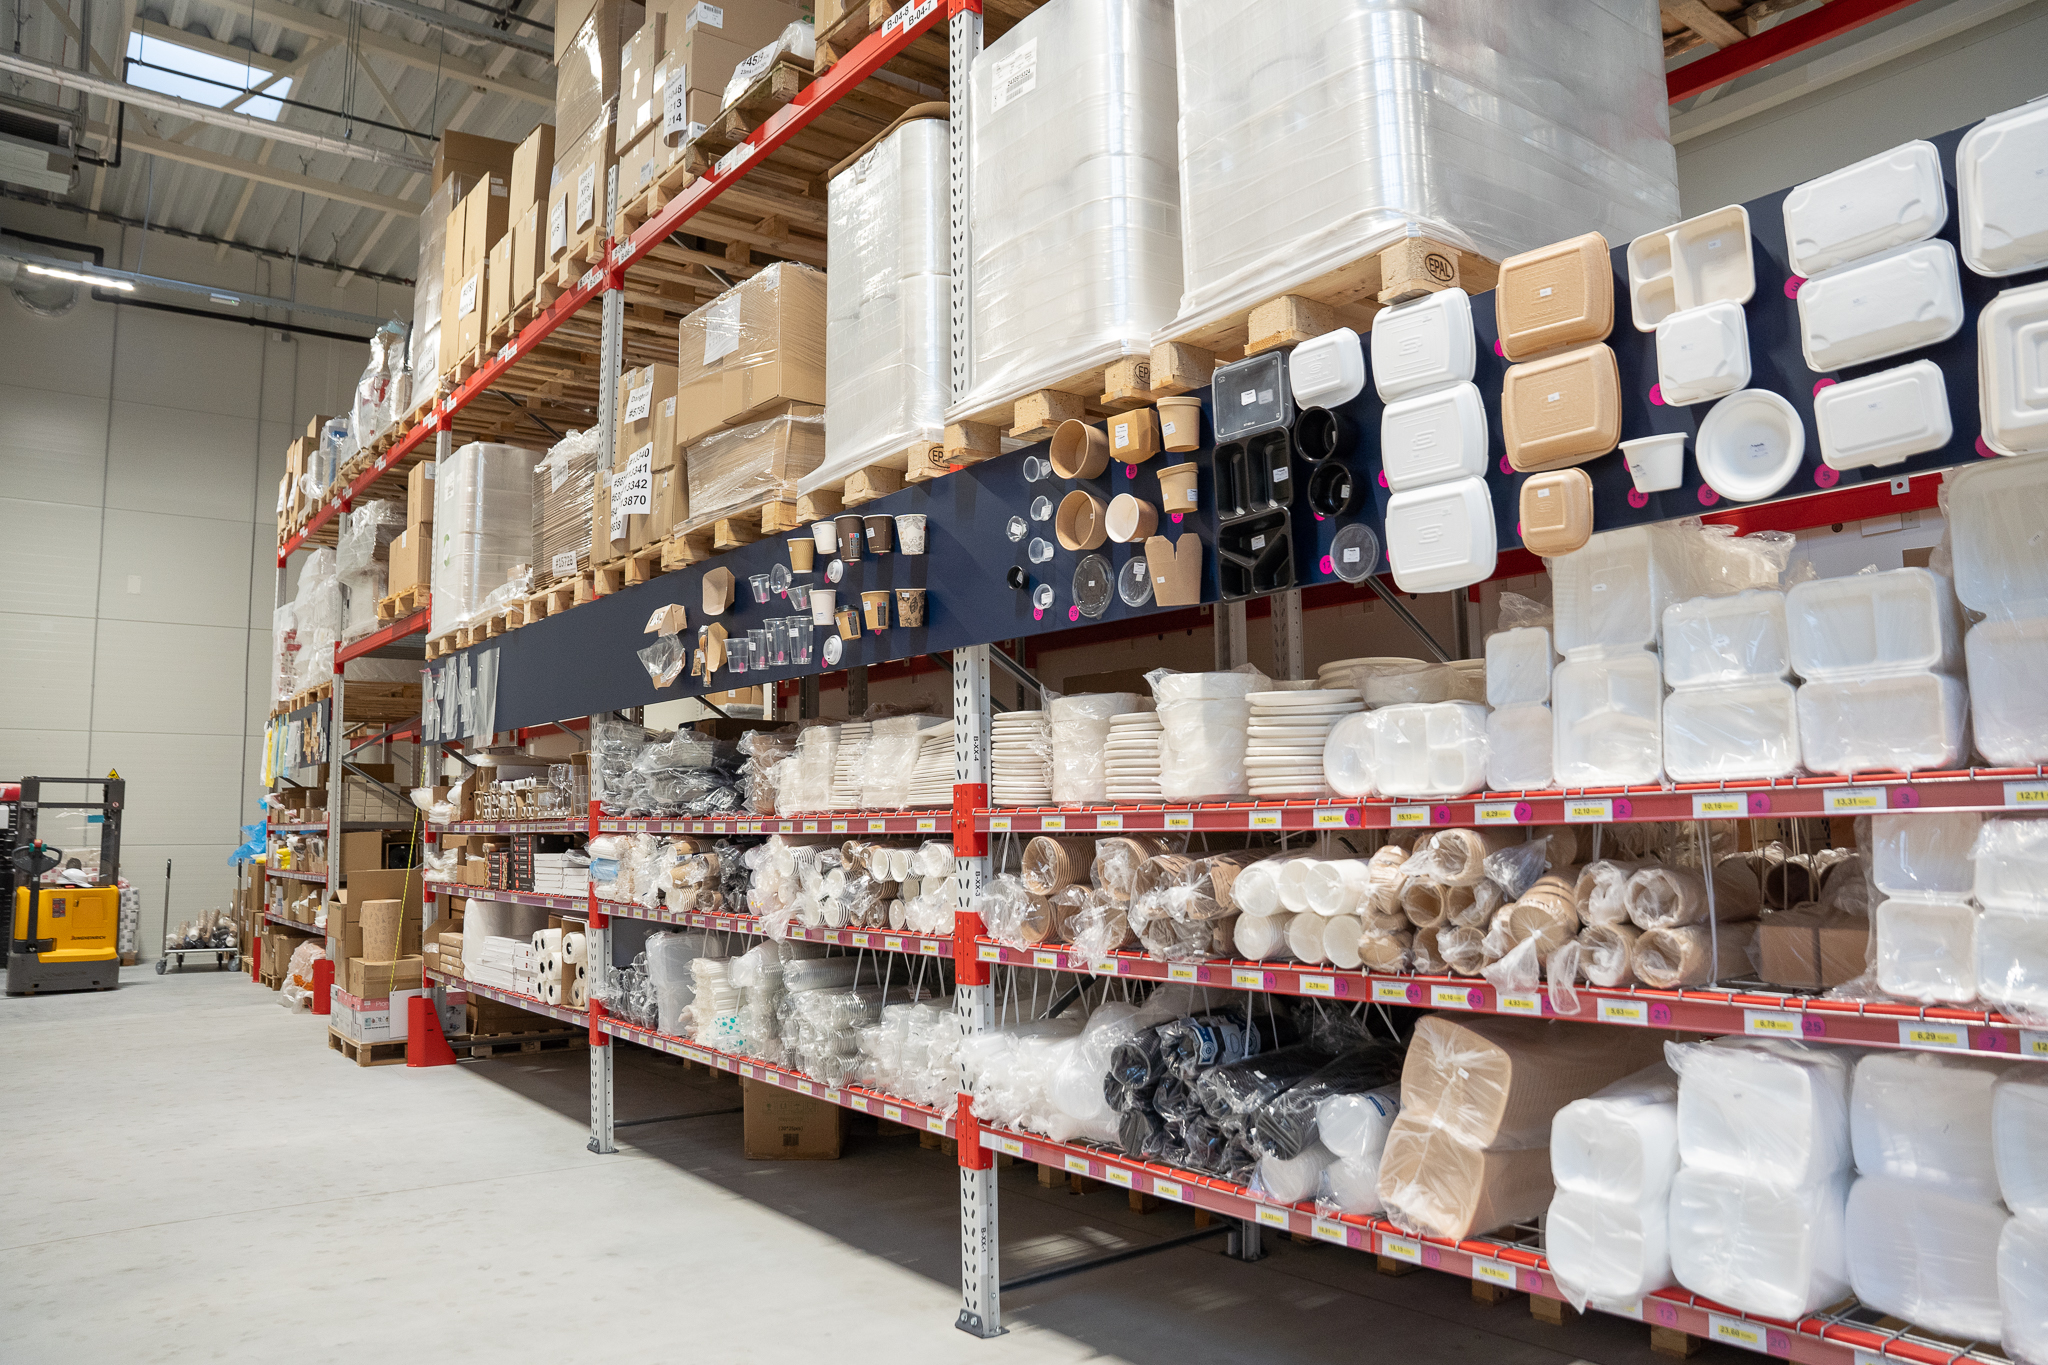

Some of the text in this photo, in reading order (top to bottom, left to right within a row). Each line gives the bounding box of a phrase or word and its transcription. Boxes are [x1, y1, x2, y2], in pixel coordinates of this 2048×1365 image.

[886, 5, 909, 30] B-04-8
[908, 1, 932, 26] B-04-7
[1429, 257, 1450, 278] EPAL
[1822, 470, 1830, 481] 5
[1756, 799, 1763, 808] 4
[1901, 794, 1909, 804] 3
[1619, 805, 1625, 813] 2
[1439, 811, 1445, 819] 6
[1336, 983, 1345, 991] 13
[1408, 989, 1419, 998] 24
[1470, 994, 1481, 1004] 23
[1654, 1009, 1668, 1019] 21
[1805, 1022, 1821, 1032] 25
[1989, 1037, 1997, 1048] 7
[1660, 1308, 1673, 1319] 12
[1770, 1336, 1786, 1349] 20
